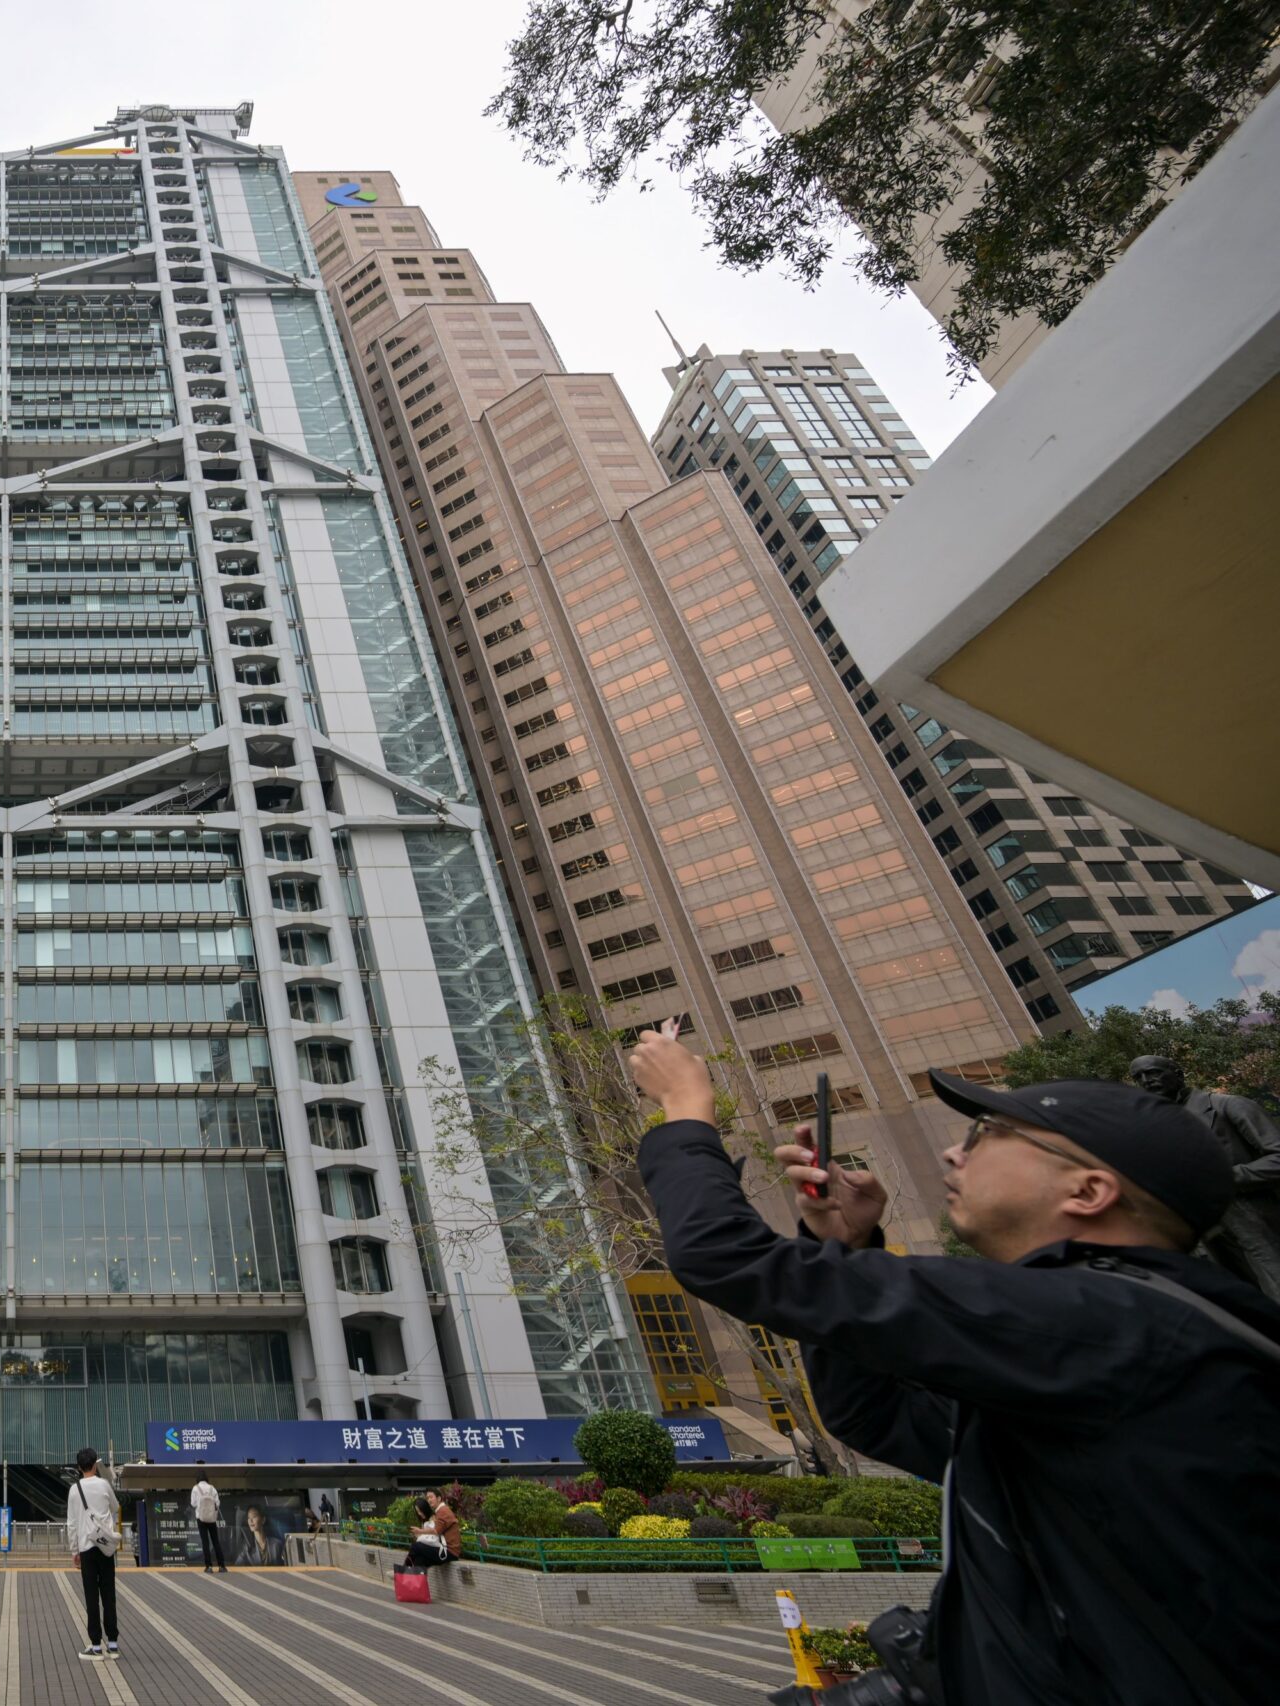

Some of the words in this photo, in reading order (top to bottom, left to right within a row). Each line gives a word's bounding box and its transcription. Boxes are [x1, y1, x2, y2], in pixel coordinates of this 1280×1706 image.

[342, 1428, 428, 1449] 財富之道
[441, 1427, 525, 1448] 盡在當下
